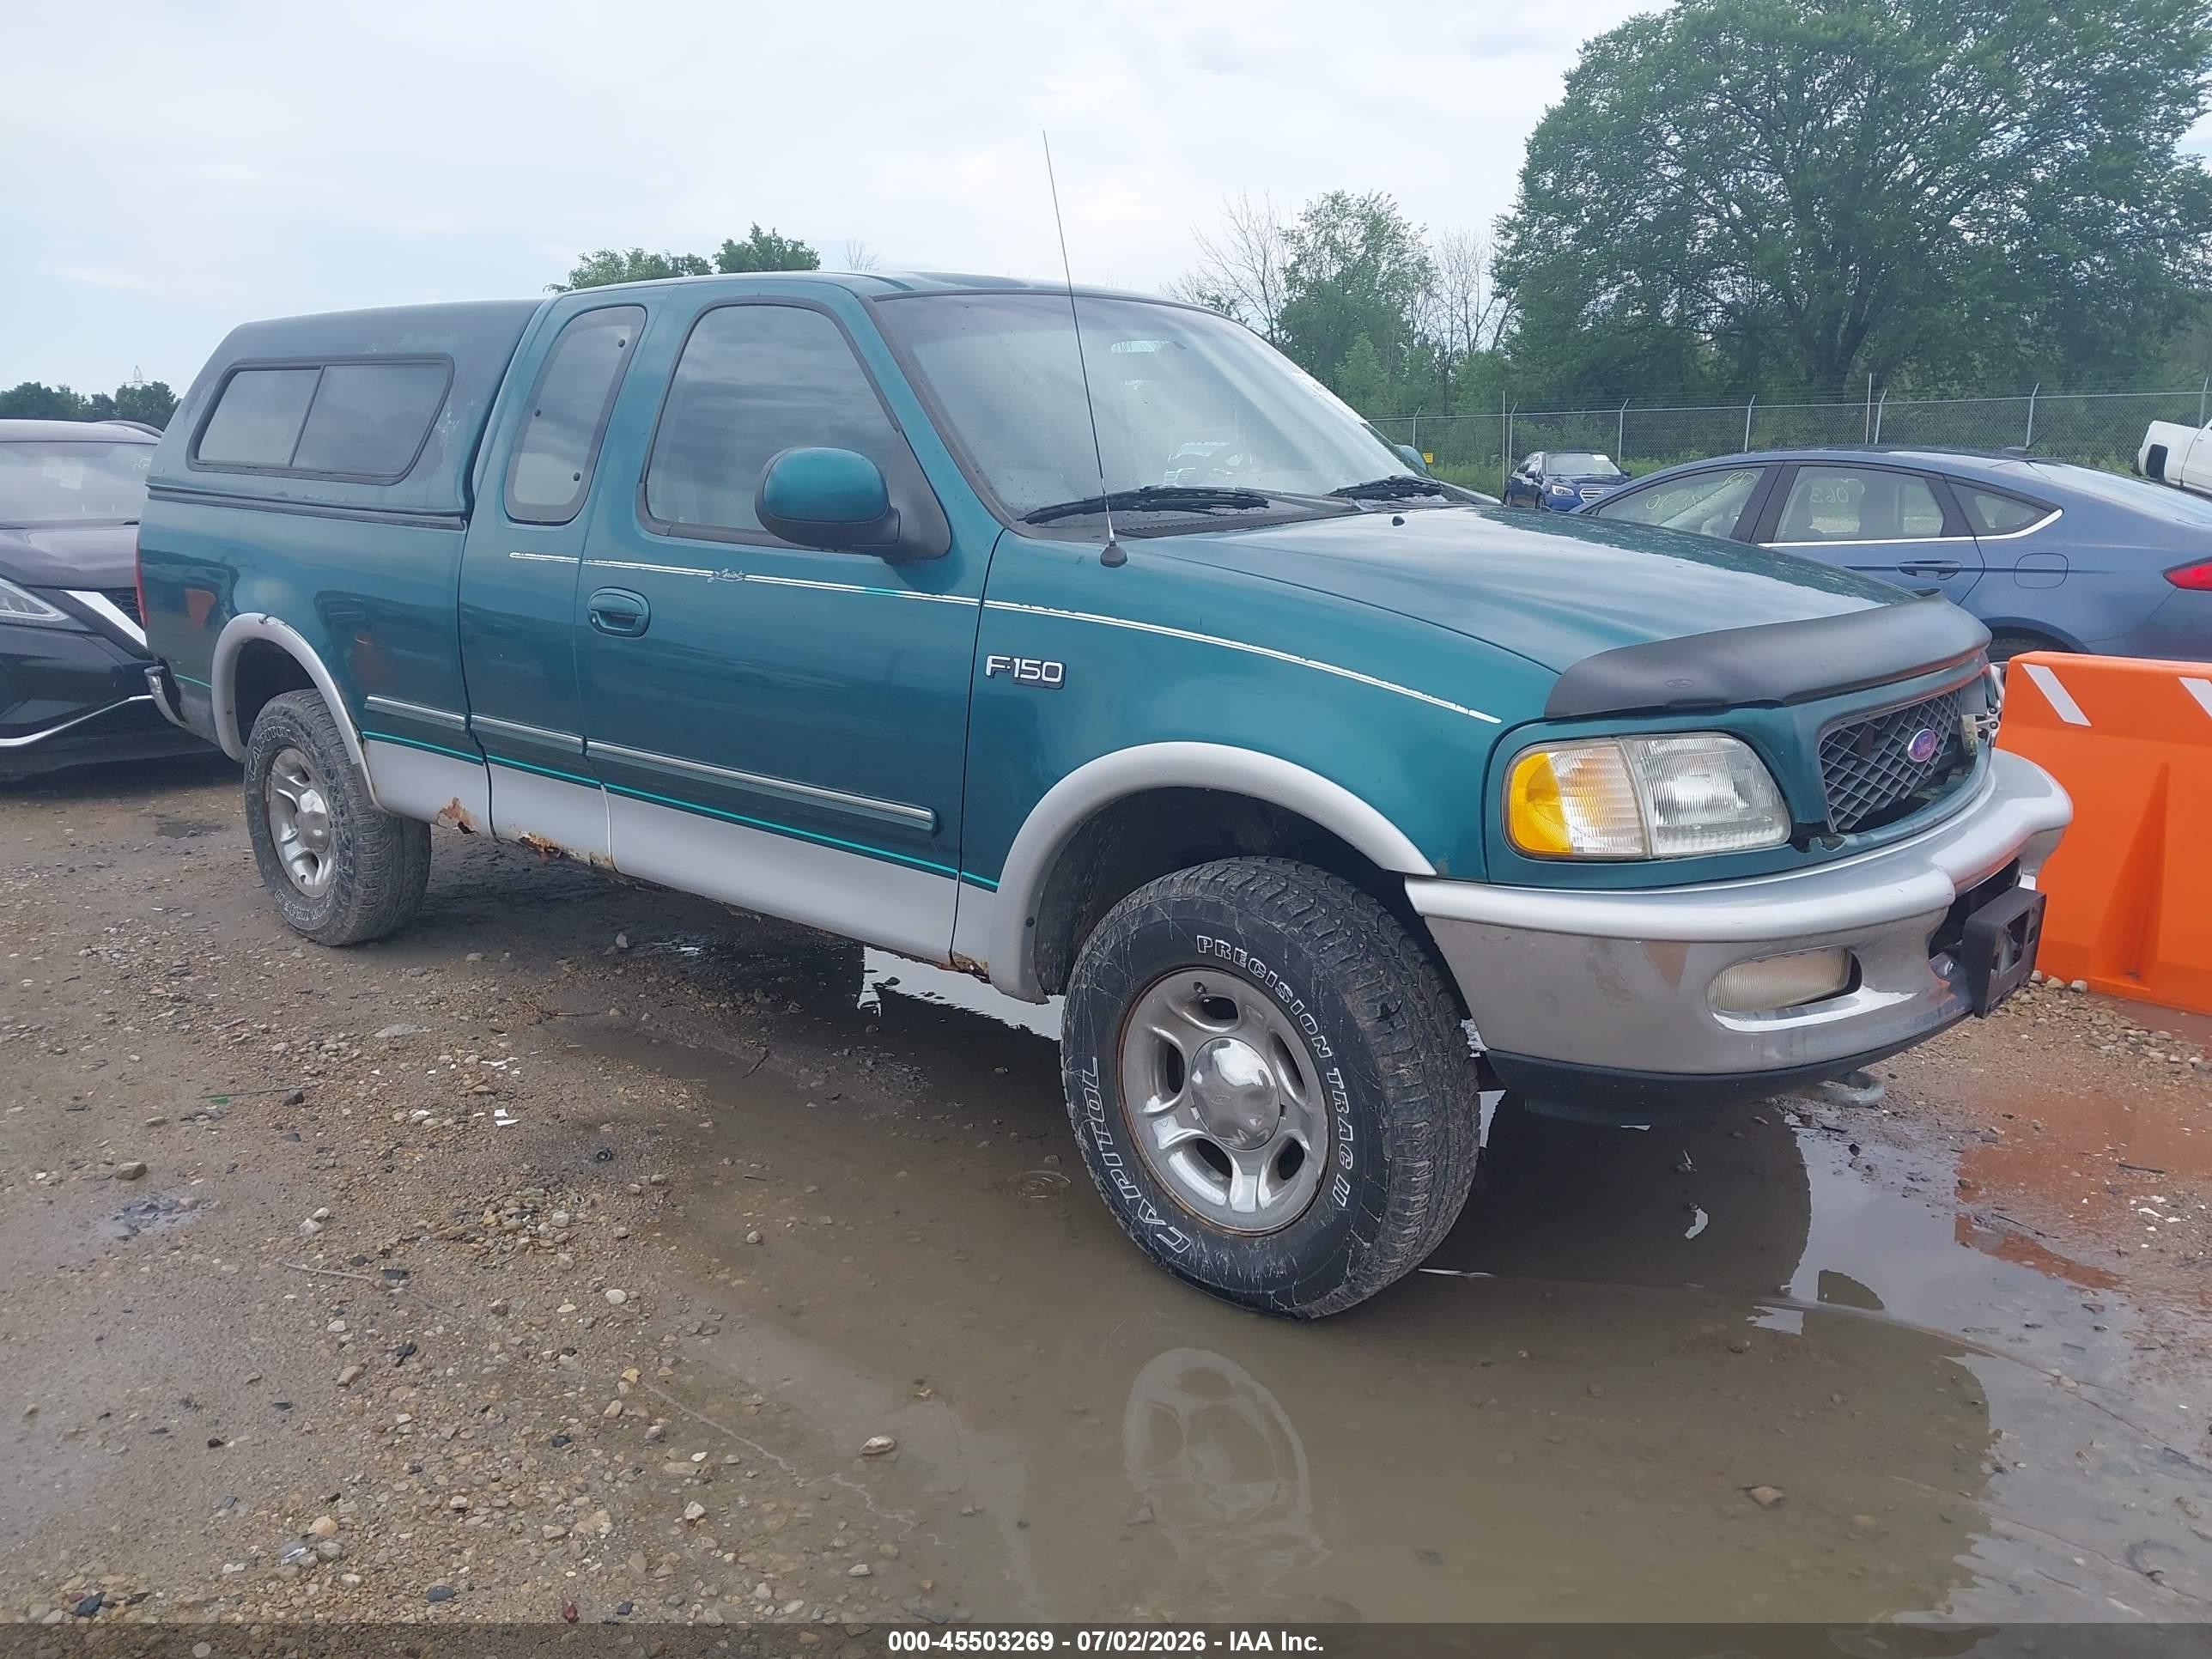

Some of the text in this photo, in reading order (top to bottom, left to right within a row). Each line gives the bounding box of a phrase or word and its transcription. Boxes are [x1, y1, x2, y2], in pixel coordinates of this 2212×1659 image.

[1196, 934, 1332, 1059] PRECISION
[1082, 1056, 1191, 1254] CAPITOL
[1326, 1066, 1354, 1170] TRAC
[1332, 1174, 1351, 1208] II
